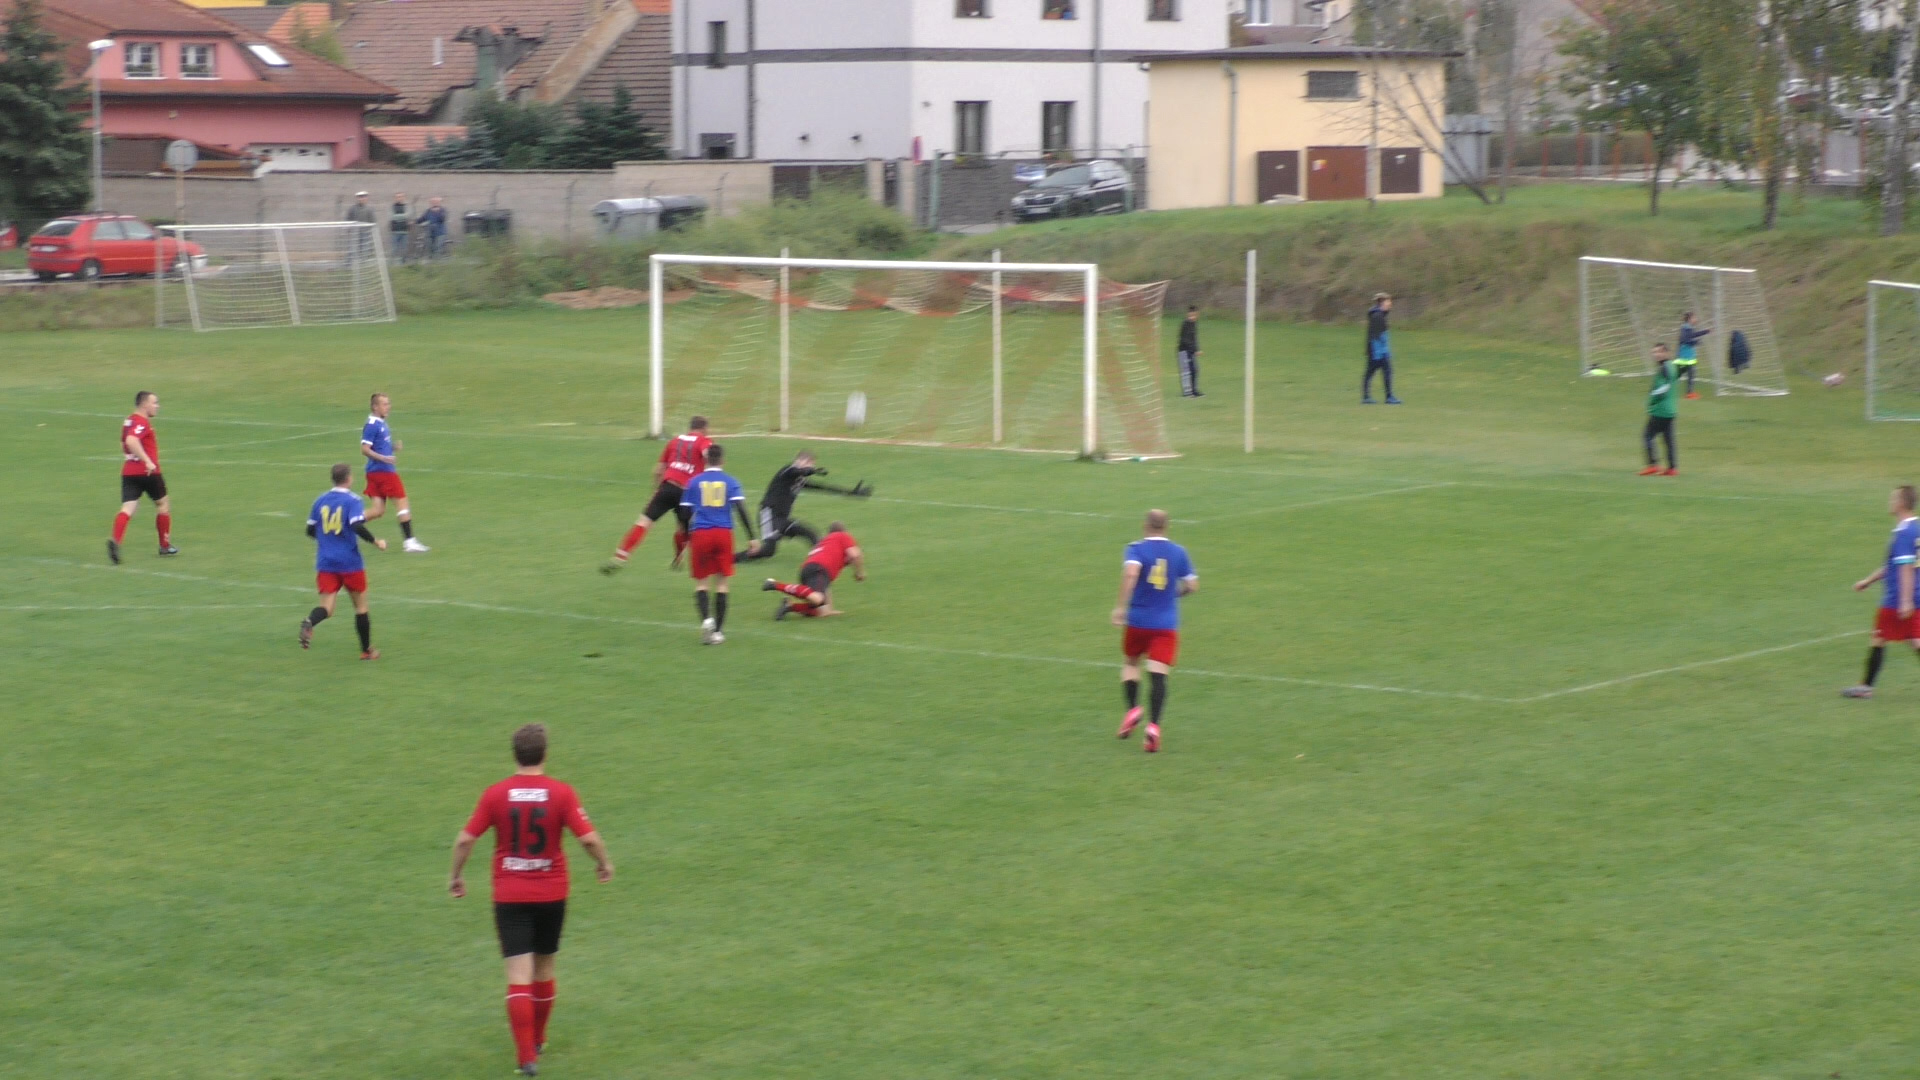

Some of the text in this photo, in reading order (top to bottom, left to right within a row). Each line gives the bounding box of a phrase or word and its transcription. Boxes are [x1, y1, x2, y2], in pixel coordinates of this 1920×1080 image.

[700, 481, 726, 507] 10
[321, 504, 342, 535] 14
[1146, 558, 1168, 590] 4
[510, 807, 547, 855] 15
